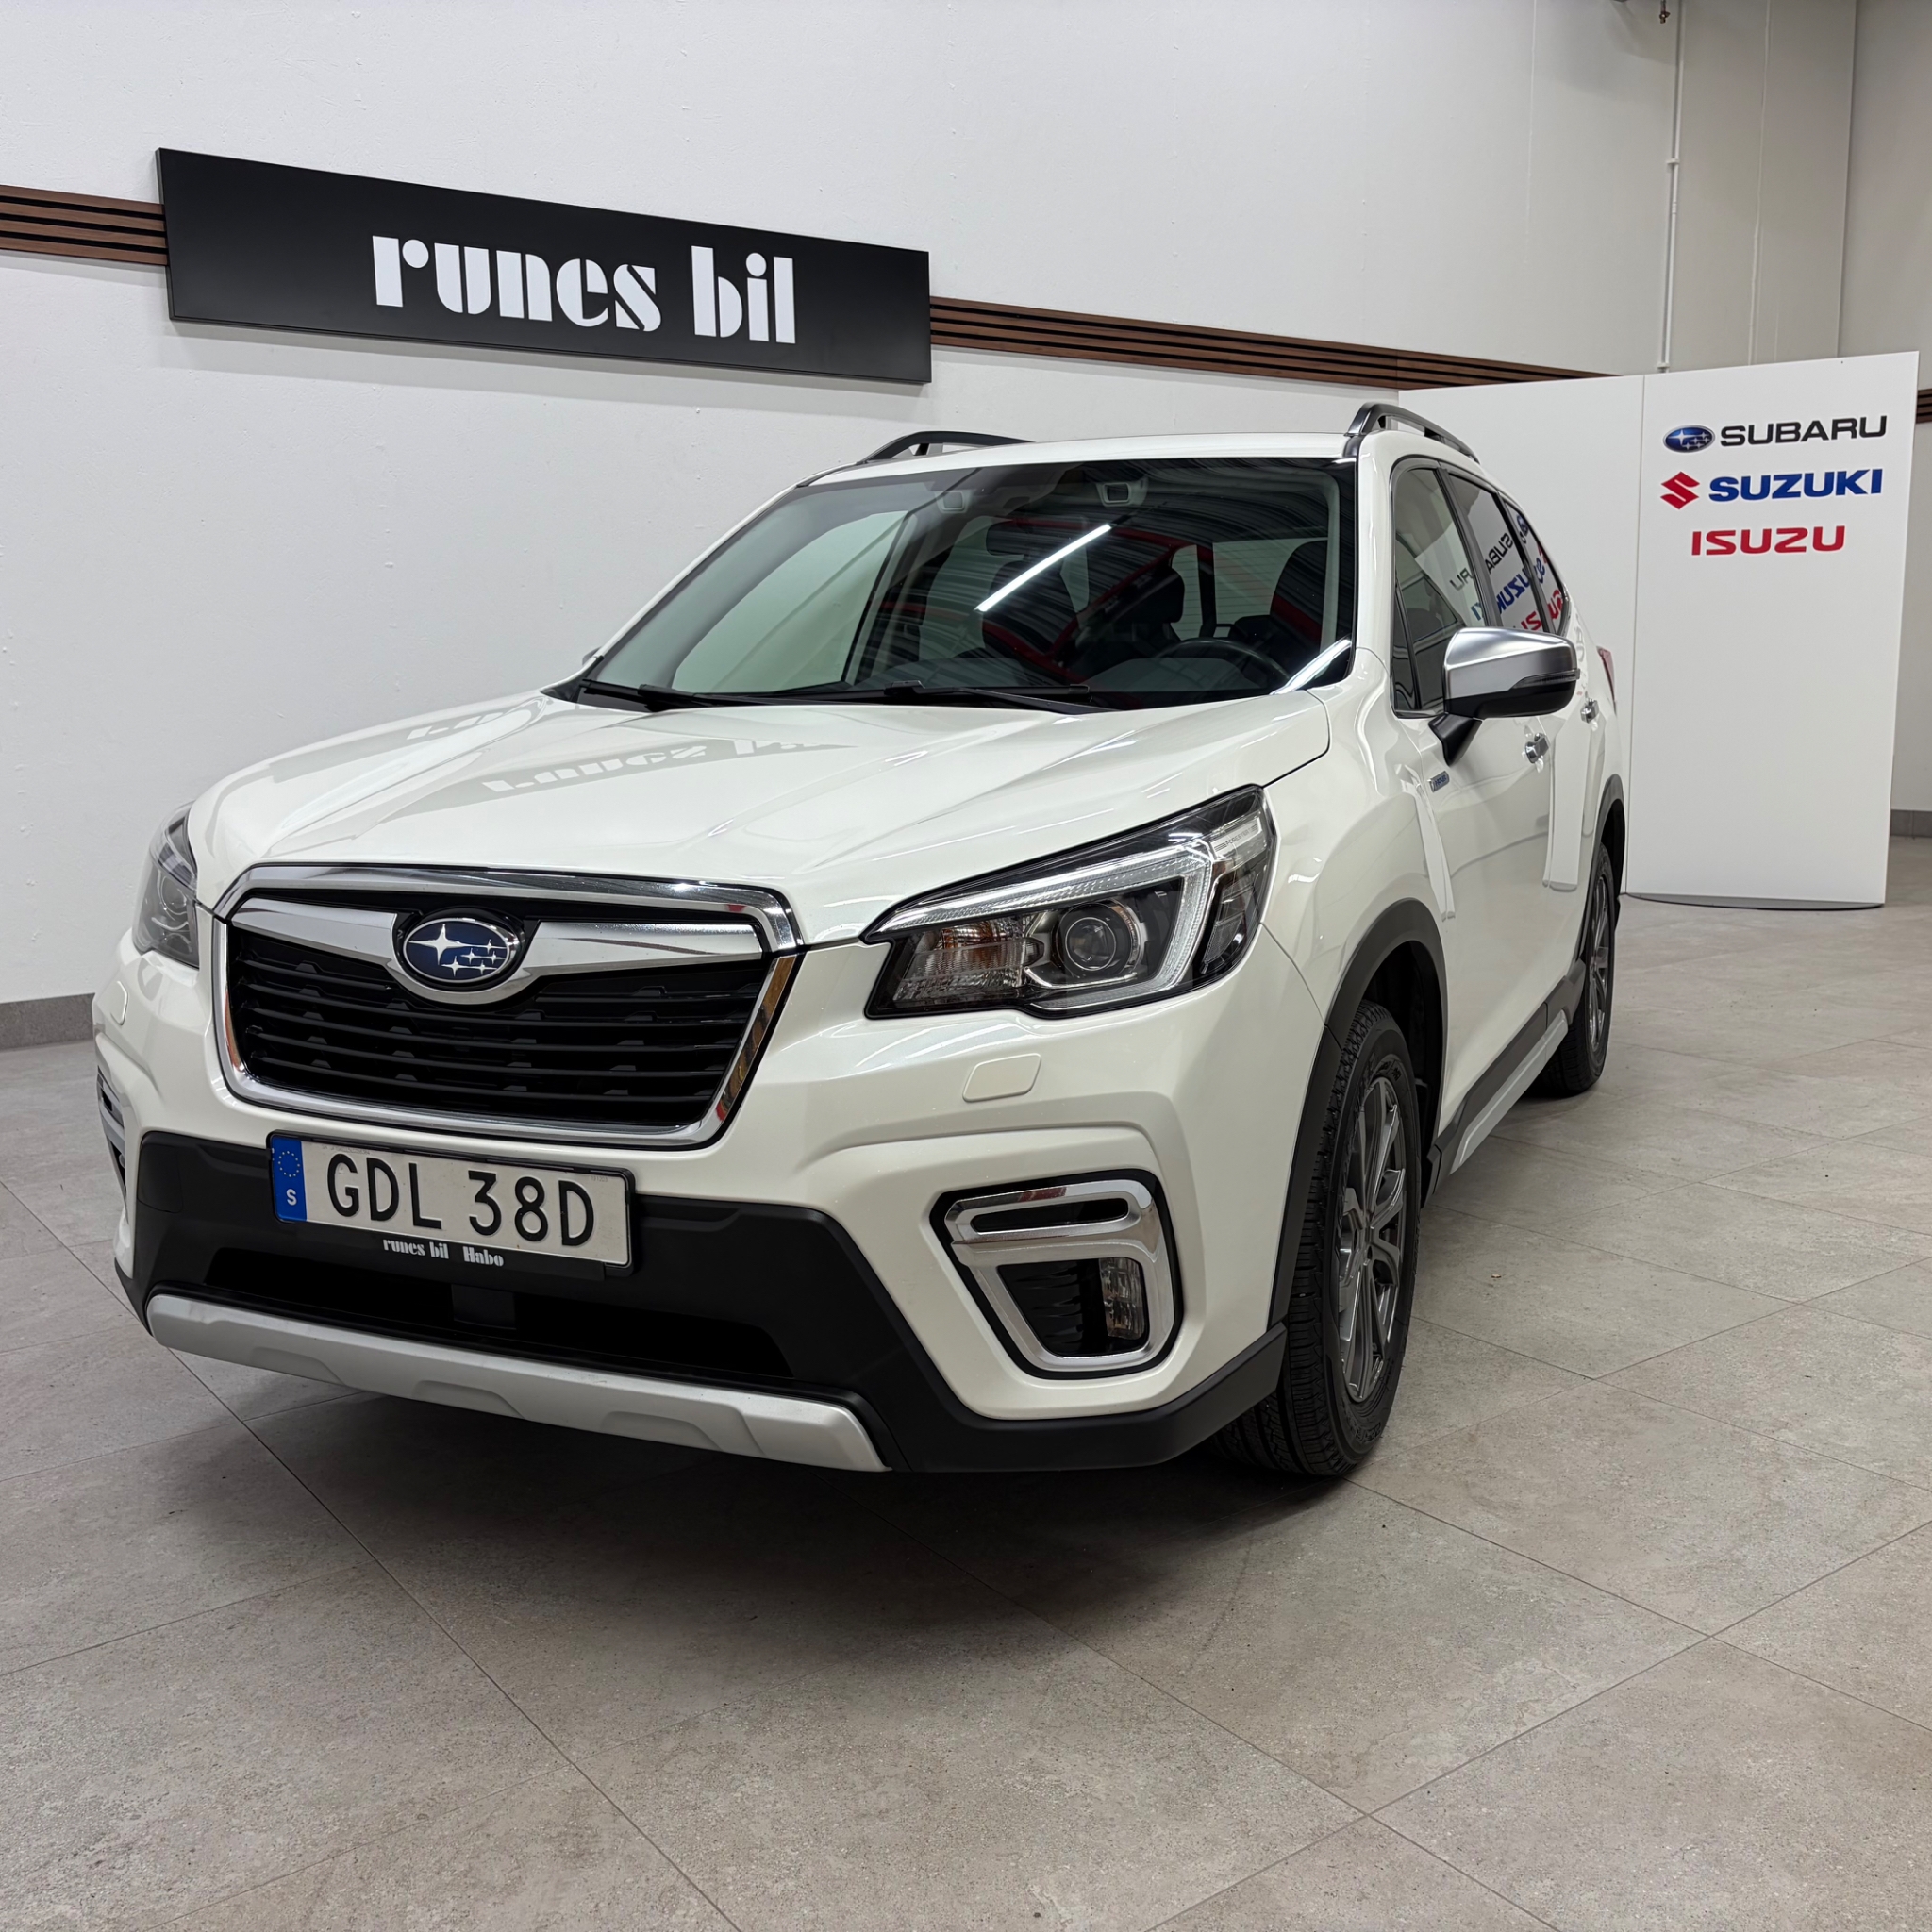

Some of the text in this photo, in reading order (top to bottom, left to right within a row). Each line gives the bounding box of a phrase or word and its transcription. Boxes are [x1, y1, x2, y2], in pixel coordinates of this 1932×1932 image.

[373, 235, 795, 344] runes bil
[1720, 415, 1887, 446] SUBARU
[1708, 469, 1883, 502] SUZUKI
[1691, 525, 1846, 556] ISUZU
[286, 1189, 297, 1206] S
[327, 1153, 594, 1246] GDL 38D
[383, 1239, 504, 1266] runes bil Habo
